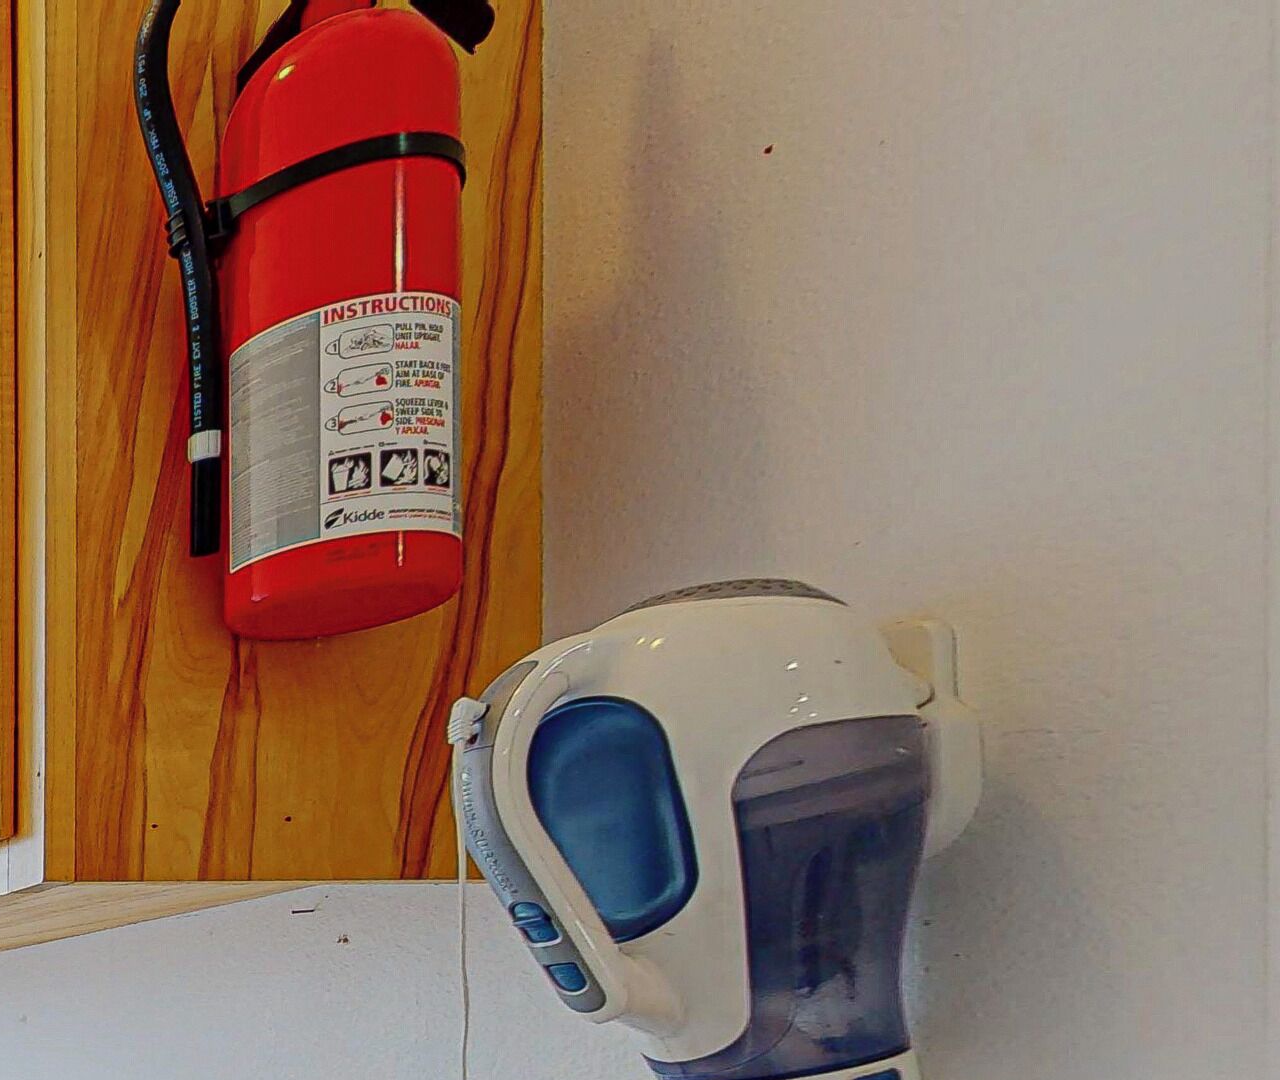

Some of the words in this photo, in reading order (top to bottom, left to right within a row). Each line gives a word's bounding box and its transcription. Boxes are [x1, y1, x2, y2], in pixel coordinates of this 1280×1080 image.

[164, 179, 179, 208] ISSUE
[183, 250, 194, 275] HOSE
[187, 279, 199, 320] BOOSTER
[324, 296, 452, 324] INSTRUCTIONS
[395, 323, 413, 331] PULL
[332, 343, 337, 352] 1
[395, 360, 417, 369] START
[419, 360, 435, 369] BACK
[193, 363, 202, 389] FIRE
[395, 370, 410, 378] AIM
[412, 370, 420, 378] AT
[330, 382, 336, 391] 2
[395, 399, 426, 408] SQUEEZE
[193, 392, 202, 428] LISTED
[395, 407, 419, 417] SWEEP
[331, 418, 336, 428] 3
[395, 427, 400, 435] Y
[343, 509, 385, 523] Kidde
